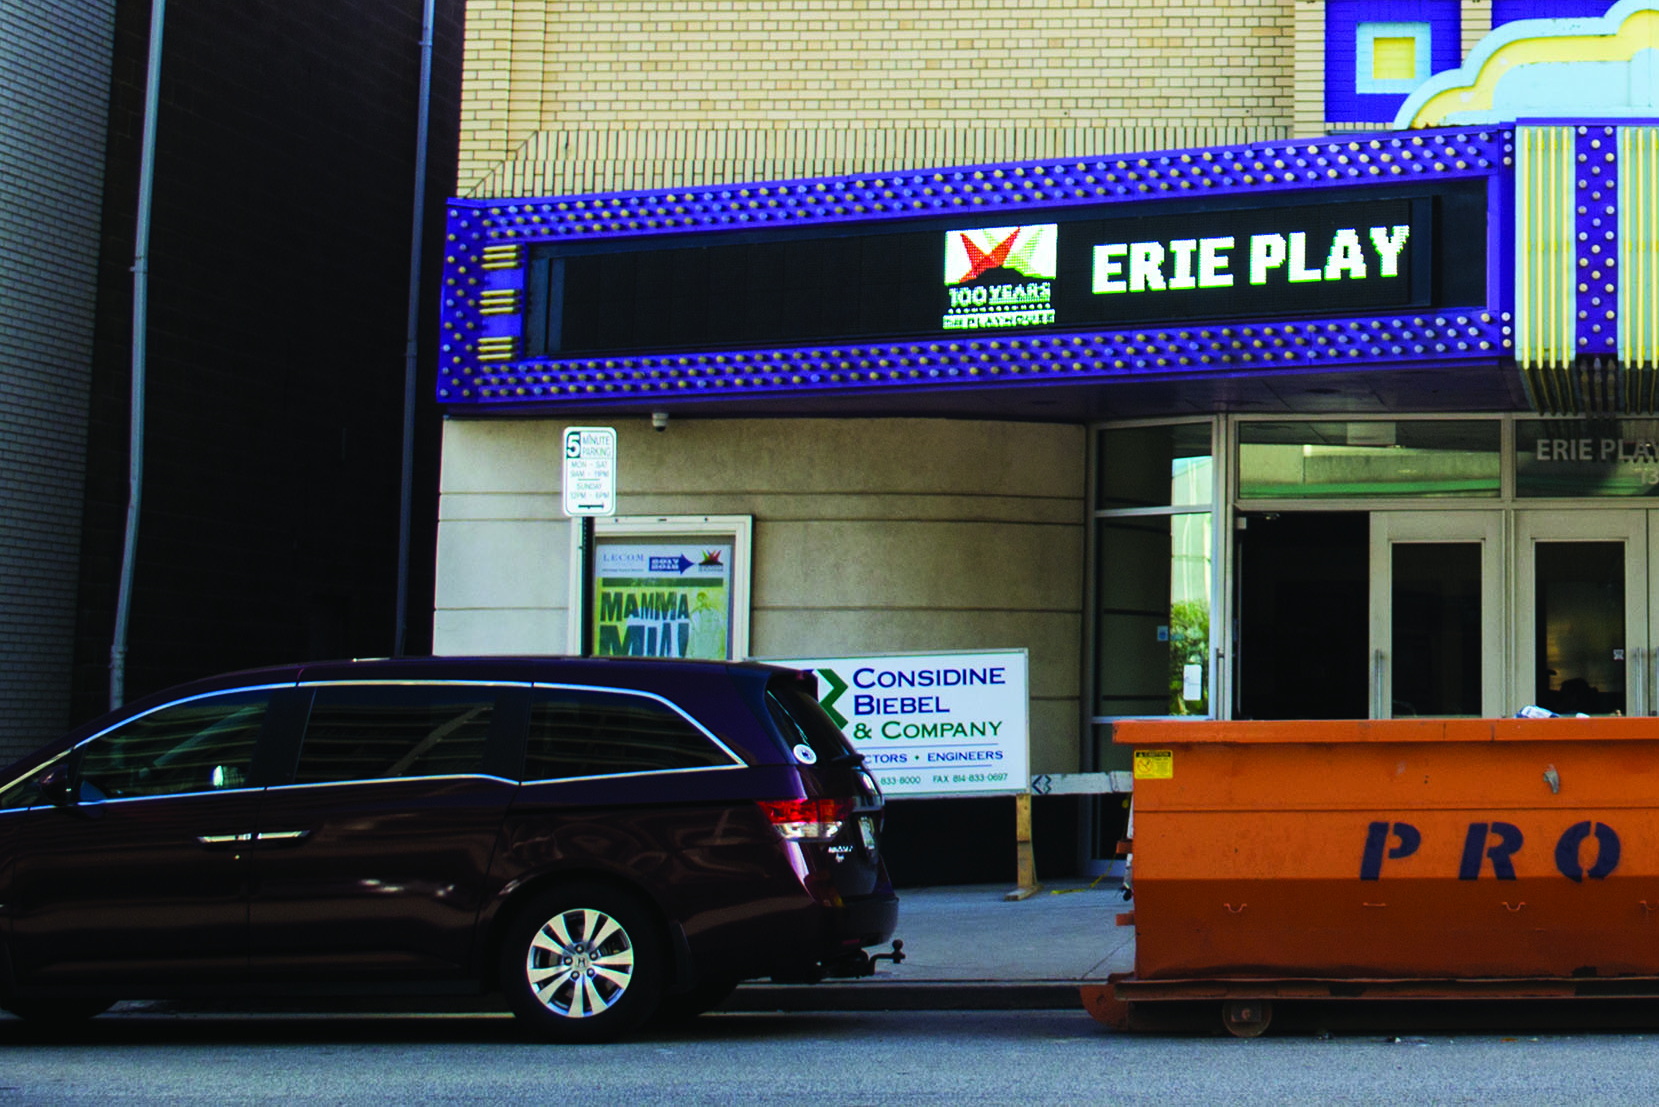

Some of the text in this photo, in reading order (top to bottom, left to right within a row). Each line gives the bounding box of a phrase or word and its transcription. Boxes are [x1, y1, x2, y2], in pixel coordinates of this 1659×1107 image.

[1092, 225, 1411, 295] ERIE PLAY
[949, 281, 1051, 307] 100 YEARS
[567, 433, 580, 457] 5
[582, 435, 610, 446] MINUTE
[582, 446, 611, 457] PARKING
[1536, 438, 1593, 461] ERIE
[603, 553, 645, 562] LECOM
[599, 591, 690, 622] MAMMA
[852, 667, 1006, 689] CONSIDINE
[854, 694, 950, 716] BIEBEL
[853, 720, 1003, 740] & COMPANY
[927, 750, 1004, 763] ENGINEERS
[932, 774, 949, 783] FAX
[1359, 820, 1622, 884] PRO
